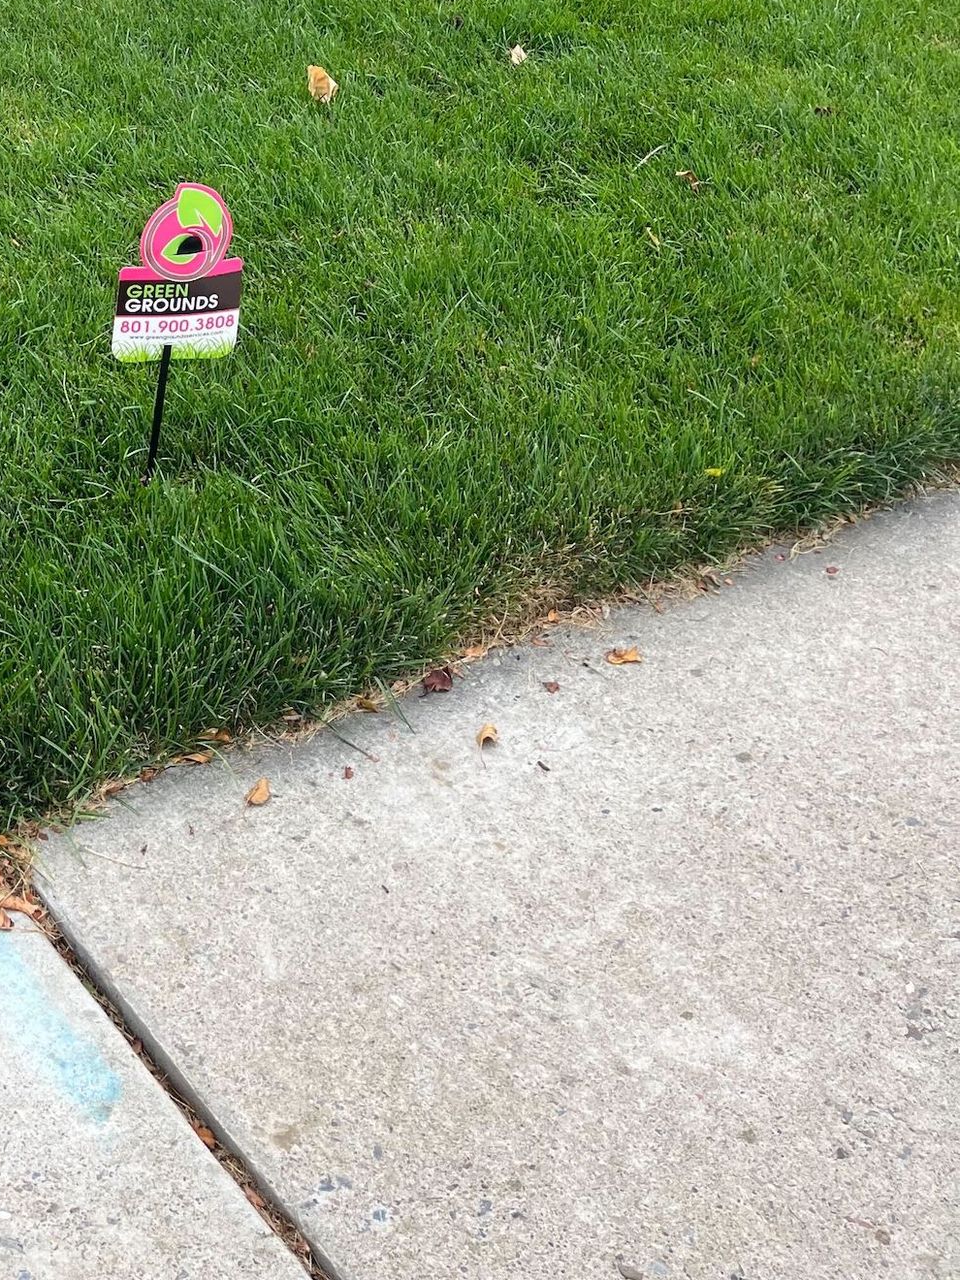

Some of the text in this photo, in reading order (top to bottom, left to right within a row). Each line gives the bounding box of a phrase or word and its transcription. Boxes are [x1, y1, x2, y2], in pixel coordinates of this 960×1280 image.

[126, 283, 189, 299] GREEN
[125, 294, 219, 313] GROUNDS
[120, 315, 235, 333] 801.900.3808
